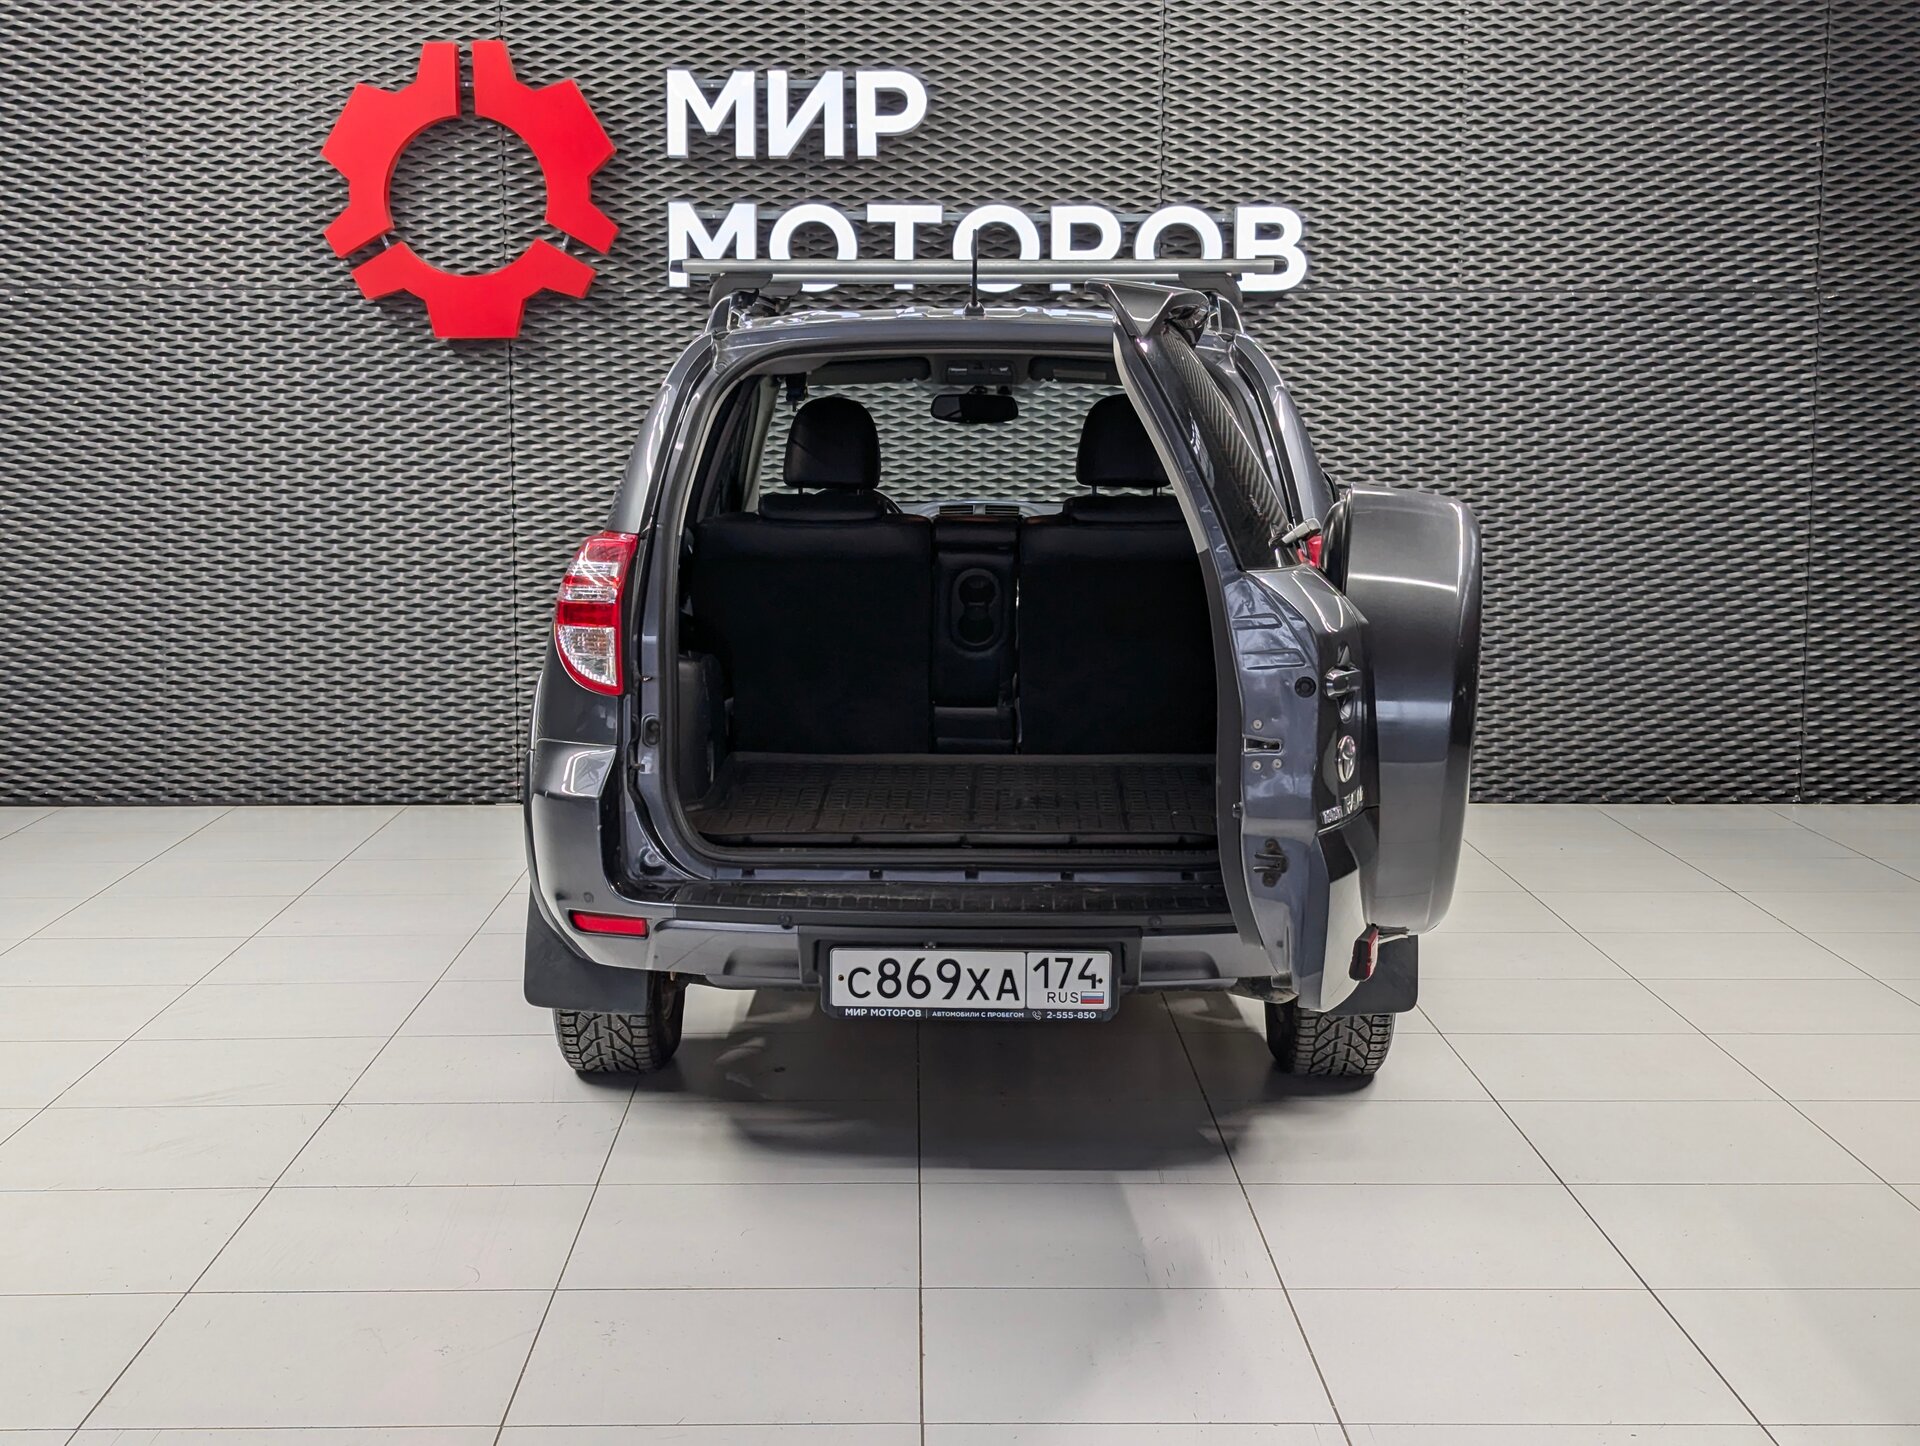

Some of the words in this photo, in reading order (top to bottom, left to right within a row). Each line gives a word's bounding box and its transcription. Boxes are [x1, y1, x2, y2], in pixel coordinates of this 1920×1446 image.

[667, 70, 927, 158] МИР
[668, 202, 1308, 292] МОТОРОВ
[847, 957, 1020, 1001] С869ХА
[1032, 957, 1098, 989] 174
[1046, 991, 1079, 1003] RUS
[844, 1008, 868, 1017] МИР
[870, 1008, 922, 1018] МОТОРОВ
[932, 1010, 979, 1018] АВТОМОБИЛИ
[1046, 1011, 1097, 1019] 2-555-850
